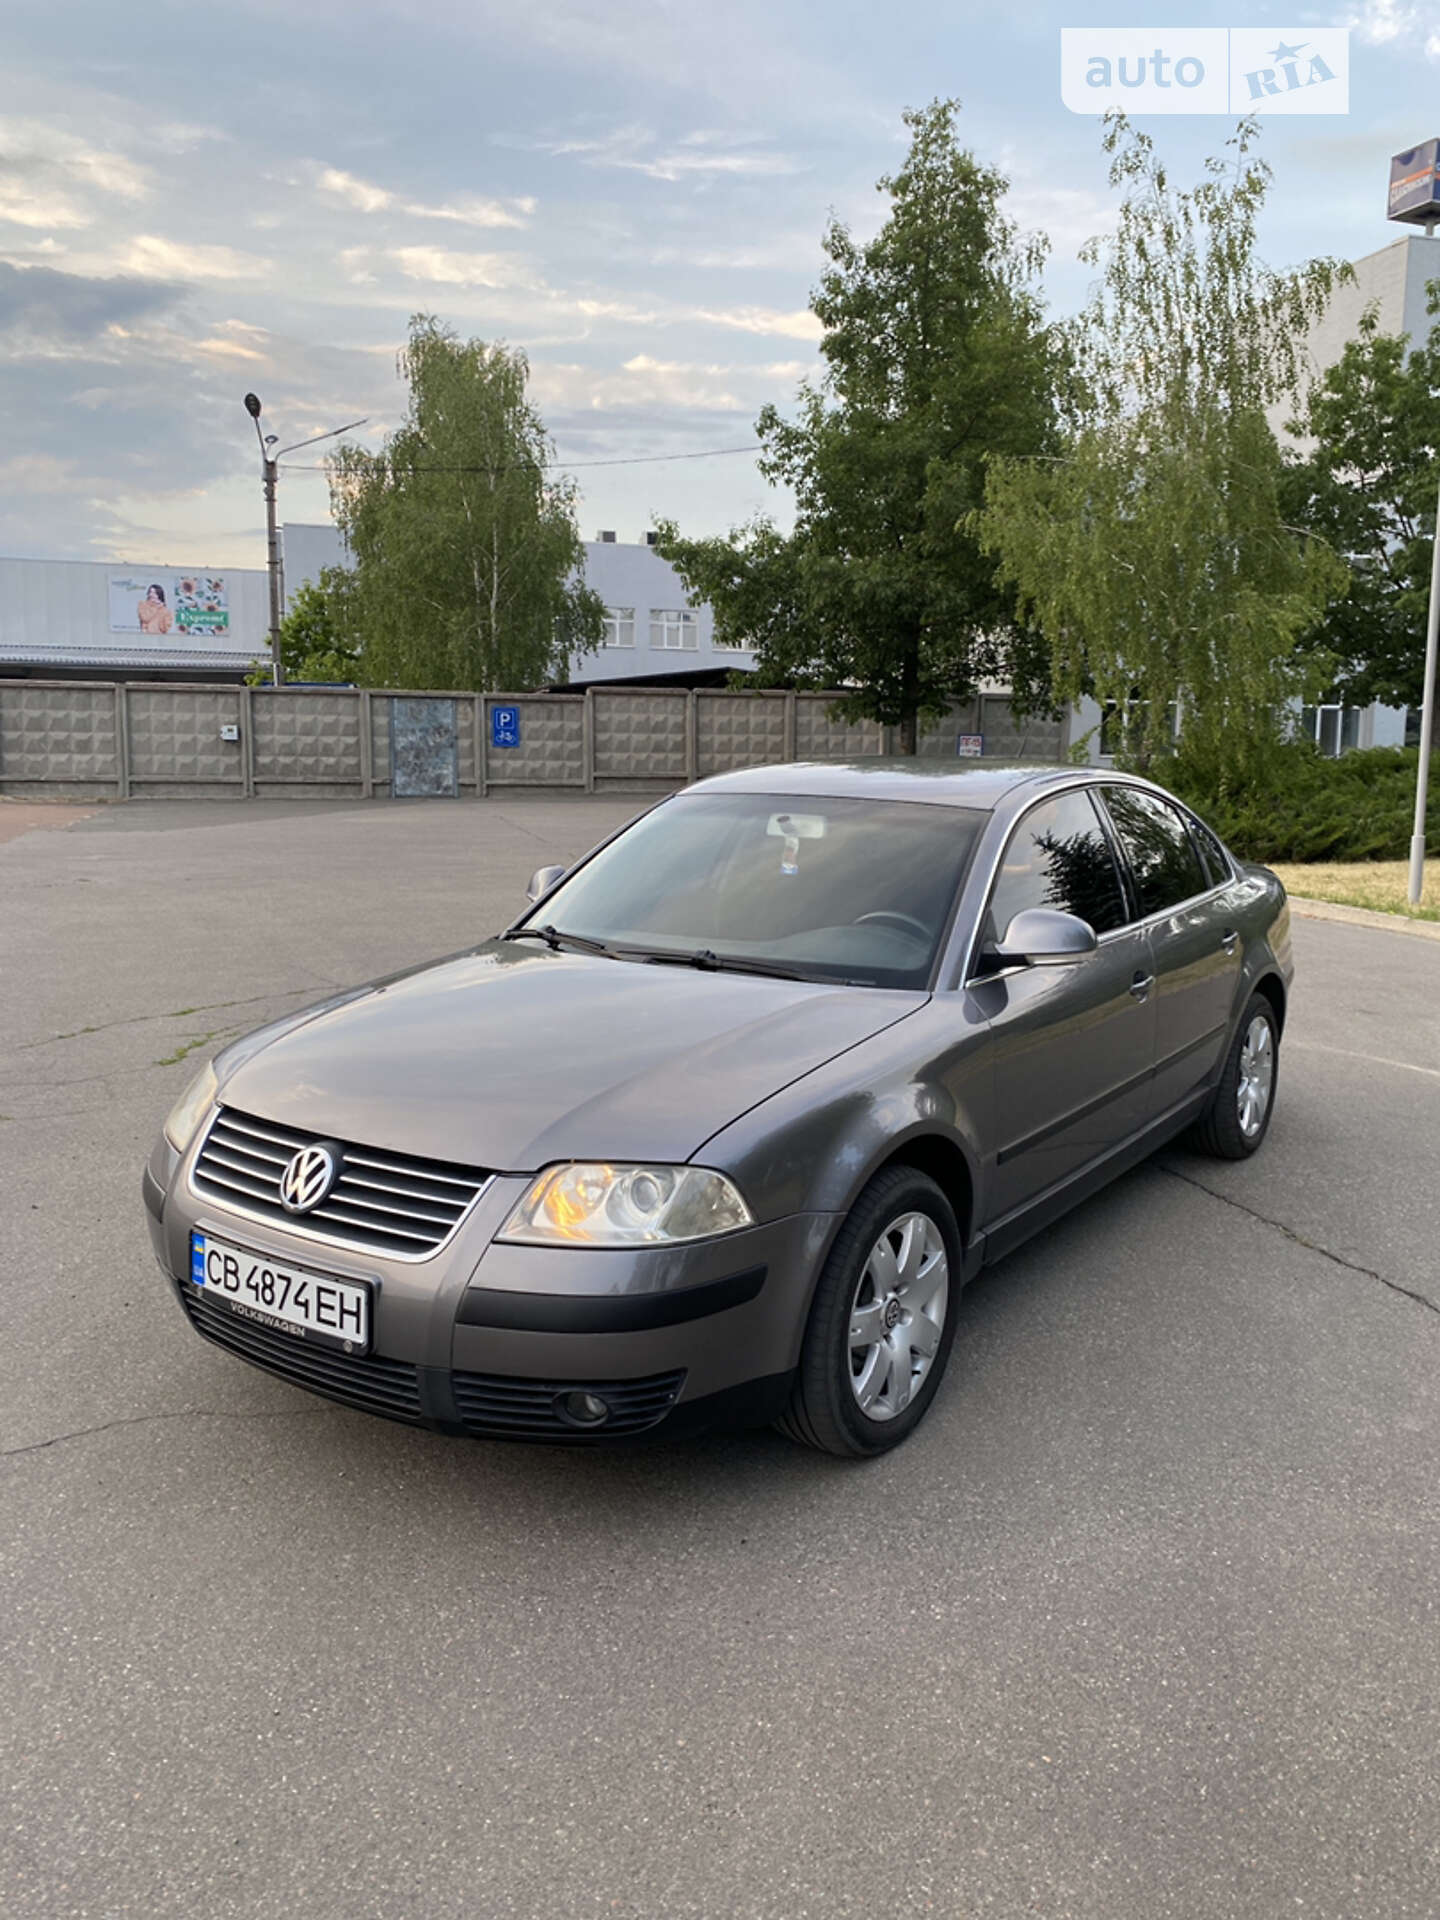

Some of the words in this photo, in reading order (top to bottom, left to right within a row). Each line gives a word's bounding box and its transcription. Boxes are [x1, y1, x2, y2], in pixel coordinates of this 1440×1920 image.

[501, 712, 511, 727] P
[207, 1249, 240, 1293] CB
[246, 1264, 309, 1320] 4874
[316, 1284, 361, 1334] EH
[230, 1302, 306, 1337] VOLKSWAGEN
